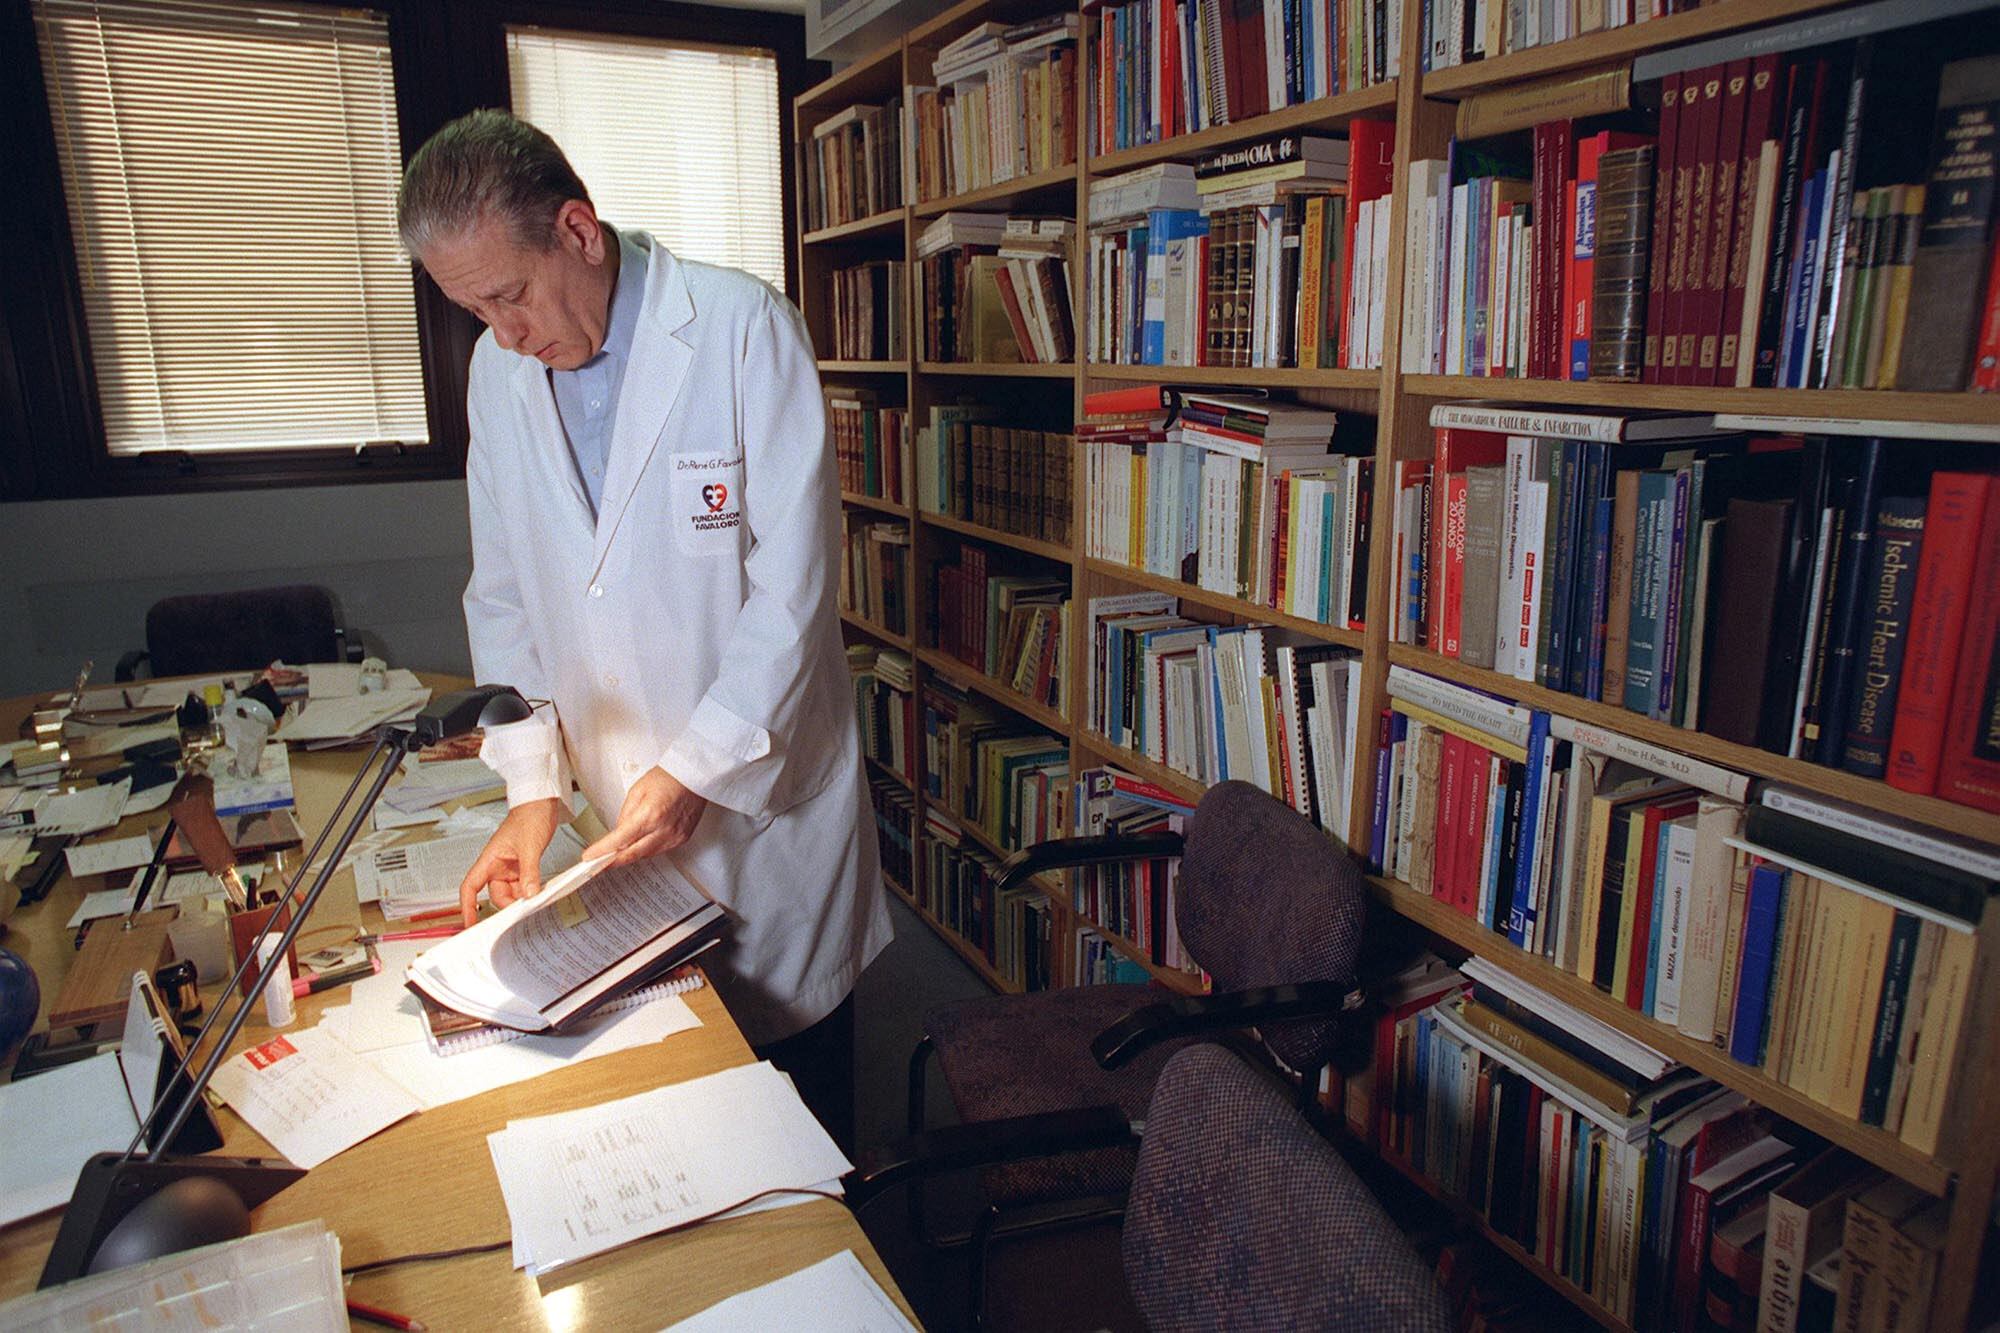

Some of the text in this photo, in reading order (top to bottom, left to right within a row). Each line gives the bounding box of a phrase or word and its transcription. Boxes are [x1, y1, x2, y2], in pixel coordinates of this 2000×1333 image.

[1249, 143, 1275, 164] OLA
[1498, 415, 1530, 431] FAILURE
[1532, 419, 1541, 432] &
[1543, 419, 1593, 437] INFARCTION
[1513, 454, 1523, 492] Radiology
[696, 519, 740, 530] FAVALORO
[1448, 501, 1459, 516] 20
[1511, 503, 1520, 534] Medical
[1645, 499, 1658, 554] International
[1878, 512, 1924, 529] Maseri
[1421, 517, 1430, 540] Artery
[1508, 535, 1518, 580] Diagnostics
[1631, 507, 1648, 608] Cardiac Surgery
[1651, 560, 1662, 582] Ford
[1640, 555, 1653, 604] Symposium
[1875, 540, 1912, 614] Ischemic
[1648, 583, 1660, 620] Hospital
[1870, 619, 1899, 668] Heart
[1431, 696, 1442, 705] TO
[1461, 708, 1476, 720] THE
[1476, 714, 1502, 729] HEART
[1857, 671, 1890, 735] Disease
[1667, 886, 1683, 980] MAZZA, ese desconocido
